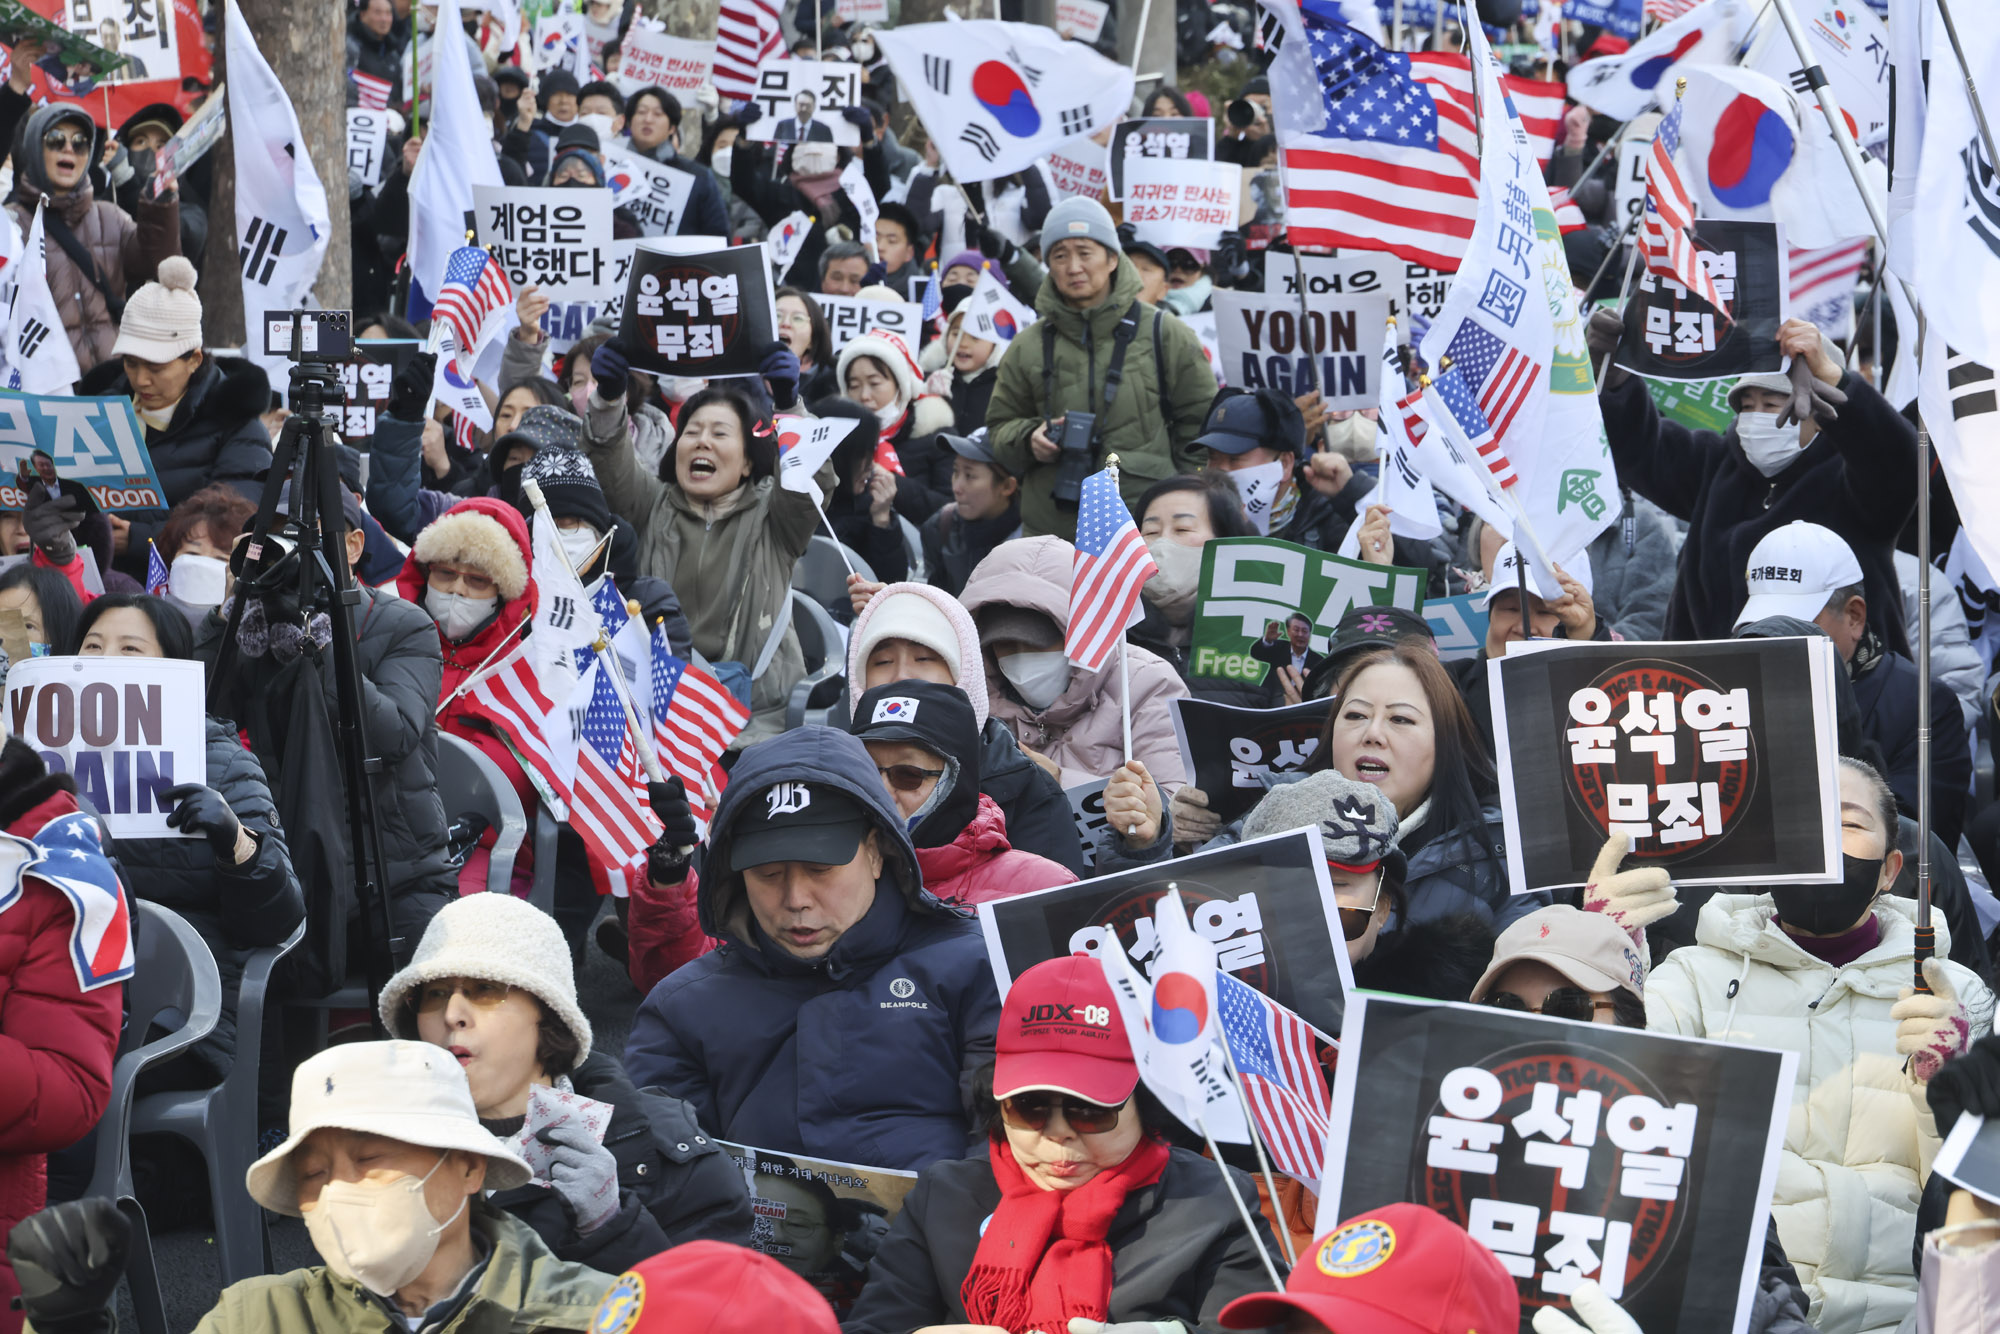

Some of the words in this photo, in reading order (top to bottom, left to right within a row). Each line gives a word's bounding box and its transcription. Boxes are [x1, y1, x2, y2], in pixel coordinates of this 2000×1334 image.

[1131, 184, 1179, 201] 지귀연
[1184, 185, 1232, 206] 판사는
[490, 203, 586, 243] 계엄은
[1130, 205, 1232, 226] 공소기각하라!
[636, 273, 739, 317] 윤석열
[656, 324, 725, 362] 무죄
[1241, 308, 1357, 355] YOON
[1645, 306, 1716, 355] 무죄
[336, 363, 392, 400] 석열
[1242, 351, 1367, 398] AGAIN
[90, 487, 158, 508] Yoon
[1751, 565, 1803, 584] 국가원로회
[1196, 648, 1260, 679] Free
[10, 682, 163, 747] YOON
[1567, 687, 1751, 765] 윤석열
[1606, 781, 1723, 853] 무죄
[880, 1001, 929, 1010] BEANPOLE
[1053, 1027, 1078, 1035] YOUR
[1080, 1030, 1111, 1040] ABILITY
[1426, 1066, 1699, 1201] 윤석열
[760, 1161, 785, 1176] 위한
[788, 1166, 813, 1181] 거대
[754, 1205, 785, 1219] AGAIN
